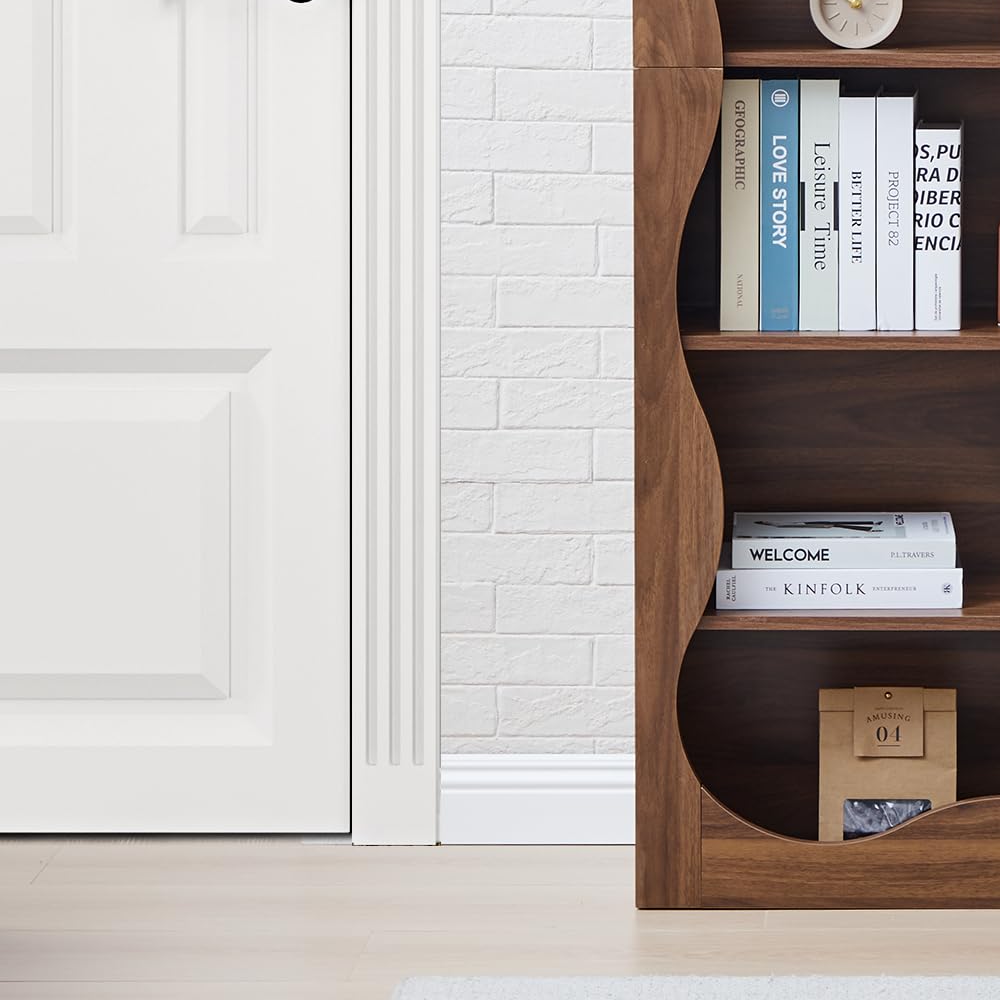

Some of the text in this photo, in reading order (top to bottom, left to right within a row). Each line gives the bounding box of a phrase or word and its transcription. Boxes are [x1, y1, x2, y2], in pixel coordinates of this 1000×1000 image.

[915, 144, 961, 163] S,PU
[772, 135, 787, 249] LOVE STORY
[915, 190, 961, 205] IBER
[813, 142, 831, 271] Leisure Time
[887, 171, 899, 246] PROJECT 82
[851, 171, 862, 264] BETTER LIFE
[749, 548, 830, 562] WELCOME
[783, 583, 866, 595] KINFOLK
[866, 712, 911, 723] AMUSING
[876, 725, 902, 742] 04
